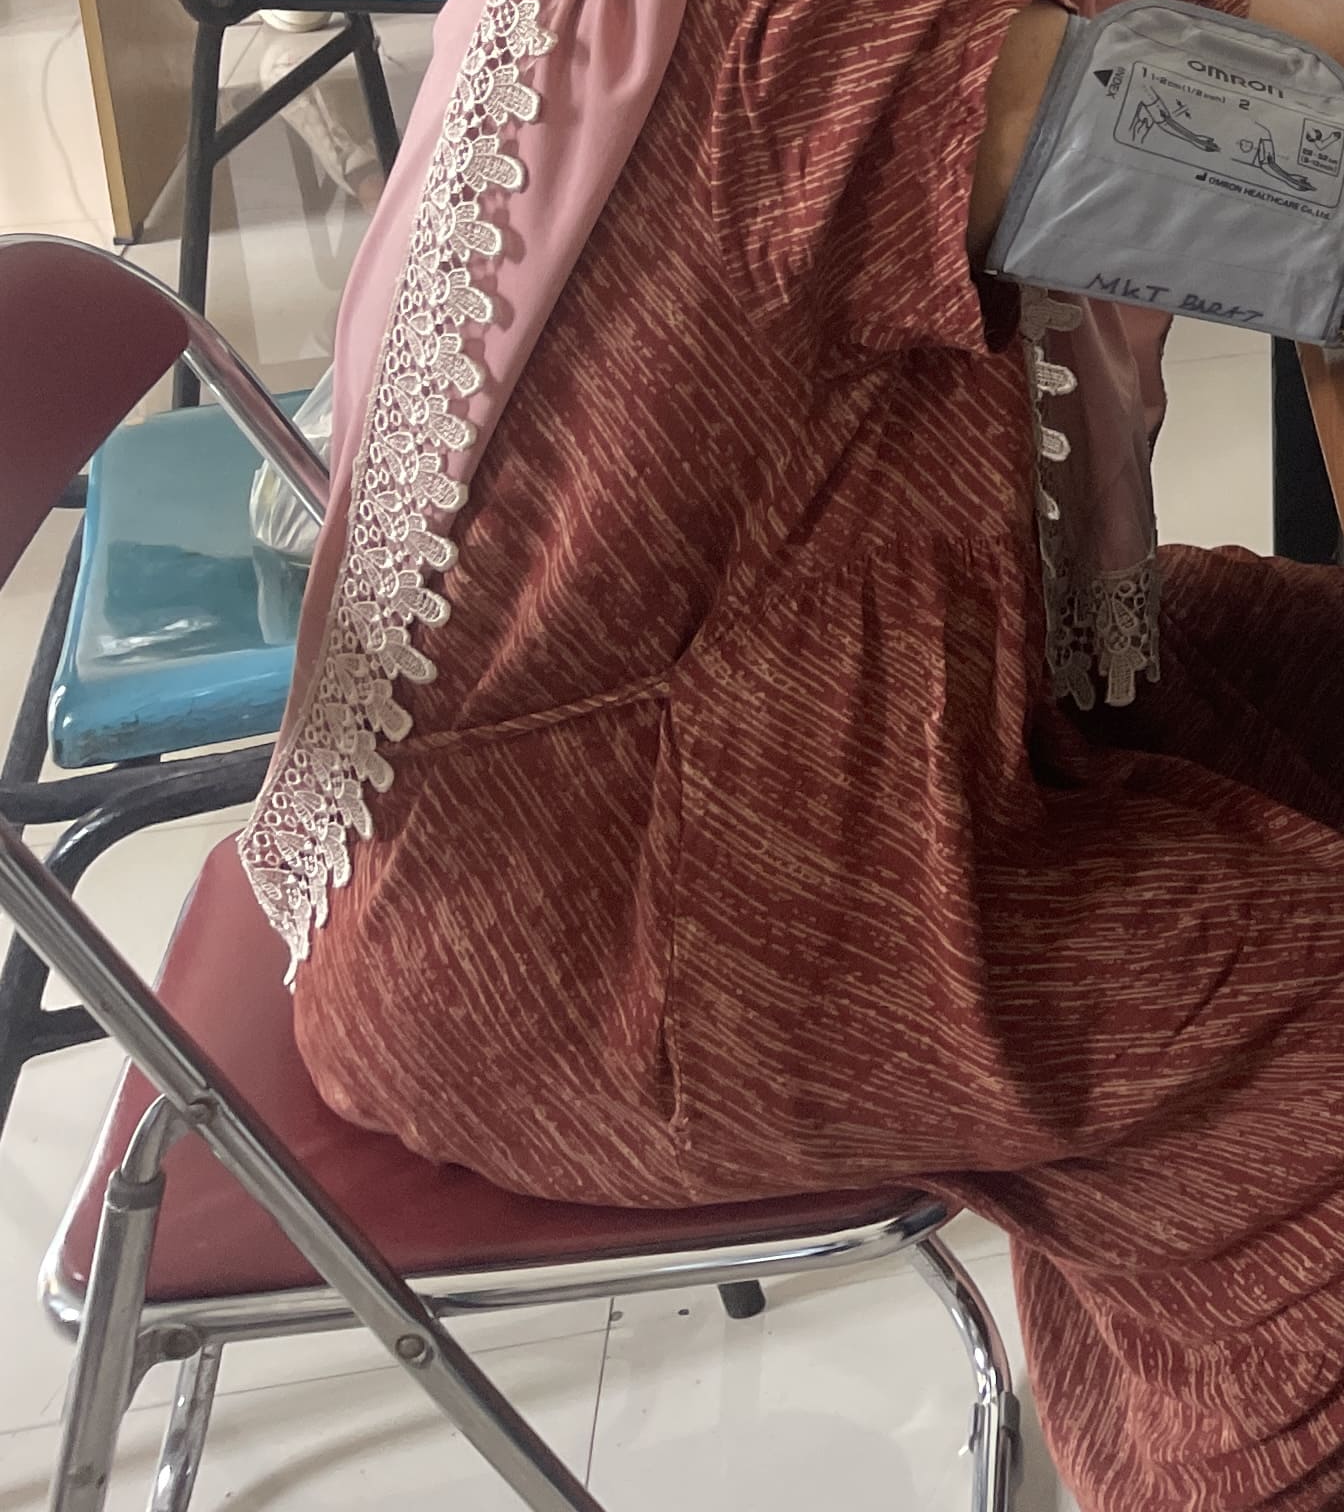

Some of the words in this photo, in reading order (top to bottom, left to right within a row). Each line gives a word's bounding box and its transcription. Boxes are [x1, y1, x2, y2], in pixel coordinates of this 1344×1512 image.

[1105, 66, 1126, 100] INDEX
[1187, 60, 1285, 99] OMRON
[1238, 99, 1251, 111] 2
[1208, 177, 1242, 193] OMRON
